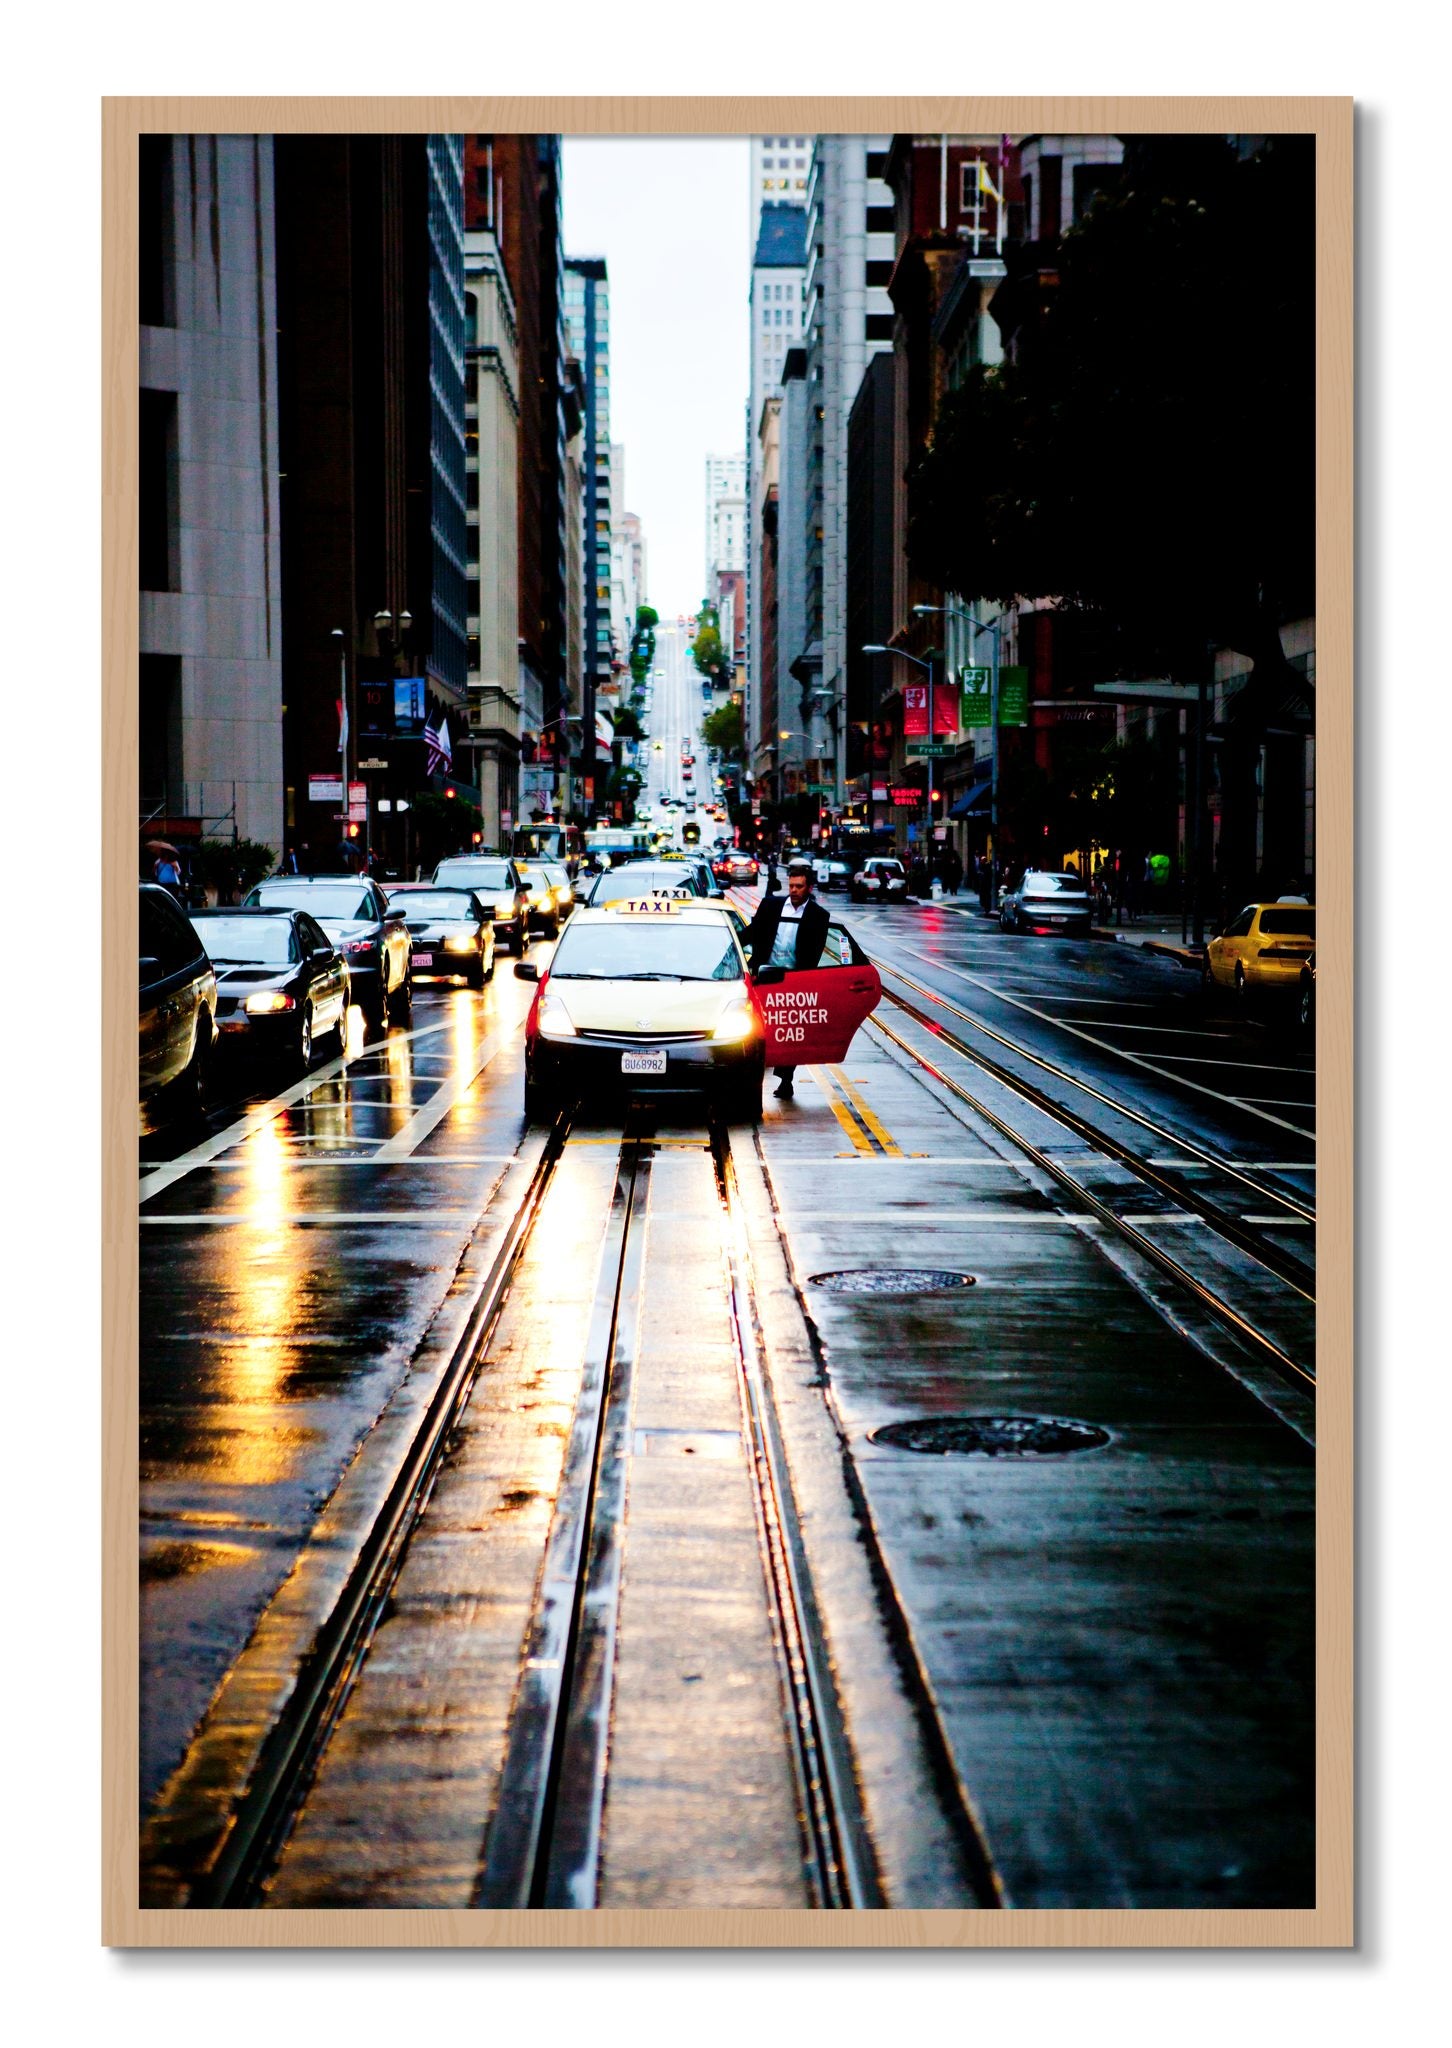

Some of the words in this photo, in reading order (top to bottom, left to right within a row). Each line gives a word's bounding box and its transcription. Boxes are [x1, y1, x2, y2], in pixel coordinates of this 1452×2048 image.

[919, 746, 943, 754] Front
[890, 788, 922, 798] TADICH
[893, 797, 918, 806] GRILL
[652, 890, 687, 899] TAXI
[628, 901, 671, 912] TAXI
[765, 991, 819, 1008] ARROW
[774, 1027, 806, 1043] CAB
[624, 1059, 664, 1071] 8U68982
